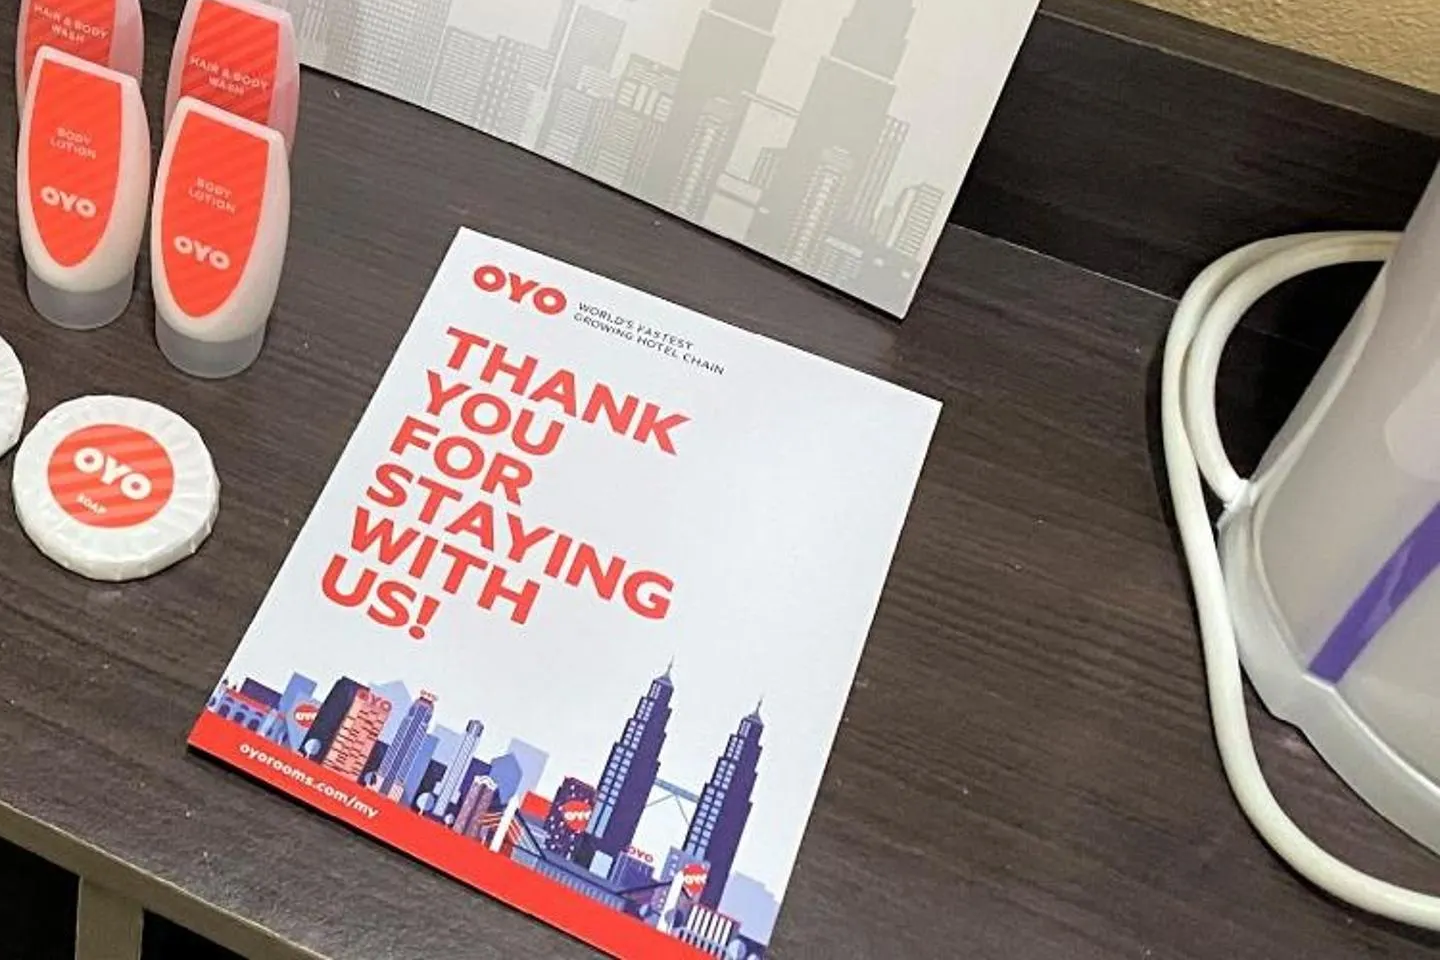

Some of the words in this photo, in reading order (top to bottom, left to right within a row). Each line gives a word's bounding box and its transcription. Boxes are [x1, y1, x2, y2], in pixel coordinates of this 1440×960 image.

[74, 20, 109, 39] BODY
[233, 71, 269, 91] BODY
[40, 185, 97, 218] OYO
[173, 235, 231, 270] OYO
[473, 265, 567, 315] OYO
[573, 312, 633, 341] GROWING
[637, 334, 679, 359] HOTEL
[682, 352, 726, 376] CHAIN
[637, 323, 695, 350] FASTEST
[424, 370, 565, 456] YOU
[446, 327, 692, 456] THANK
[73, 447, 152, 501] OYO
[390, 415, 533, 506] FOR
[349, 506, 541, 626] WITH
[365, 463, 676, 620] STAYING
[320, 553, 440, 641] US!
[239, 743, 380, 819] oyorooms.com/my
